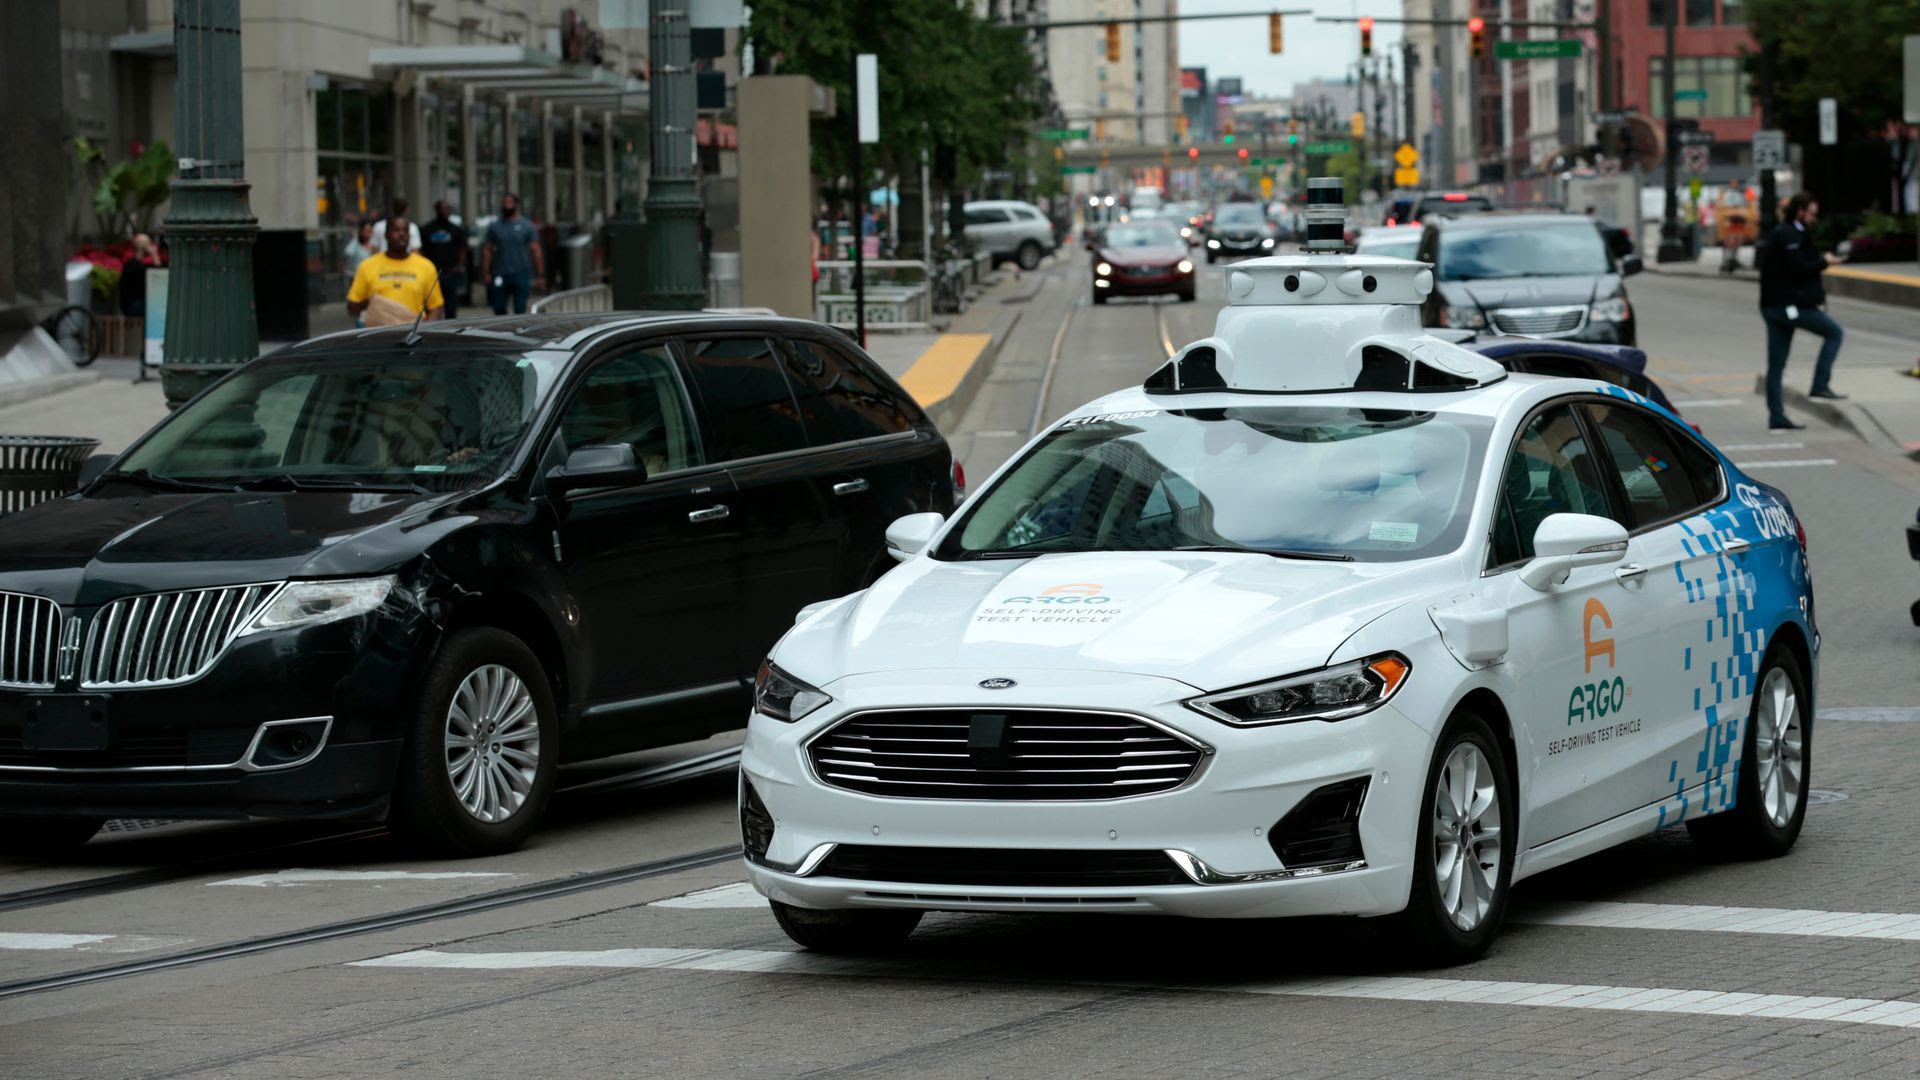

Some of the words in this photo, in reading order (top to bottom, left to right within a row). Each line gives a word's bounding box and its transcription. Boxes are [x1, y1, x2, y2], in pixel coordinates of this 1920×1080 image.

[1736, 482, 1797, 540] Ford
[1002, 596, 1111, 605] ARGO
[1567, 676, 1624, 726] ARGO
[1548, 730, 1596, 756] SELF-DRIVING
[1598, 726, 1614, 743] TEST
[1615, 718, 1642, 737] VEHICLE
